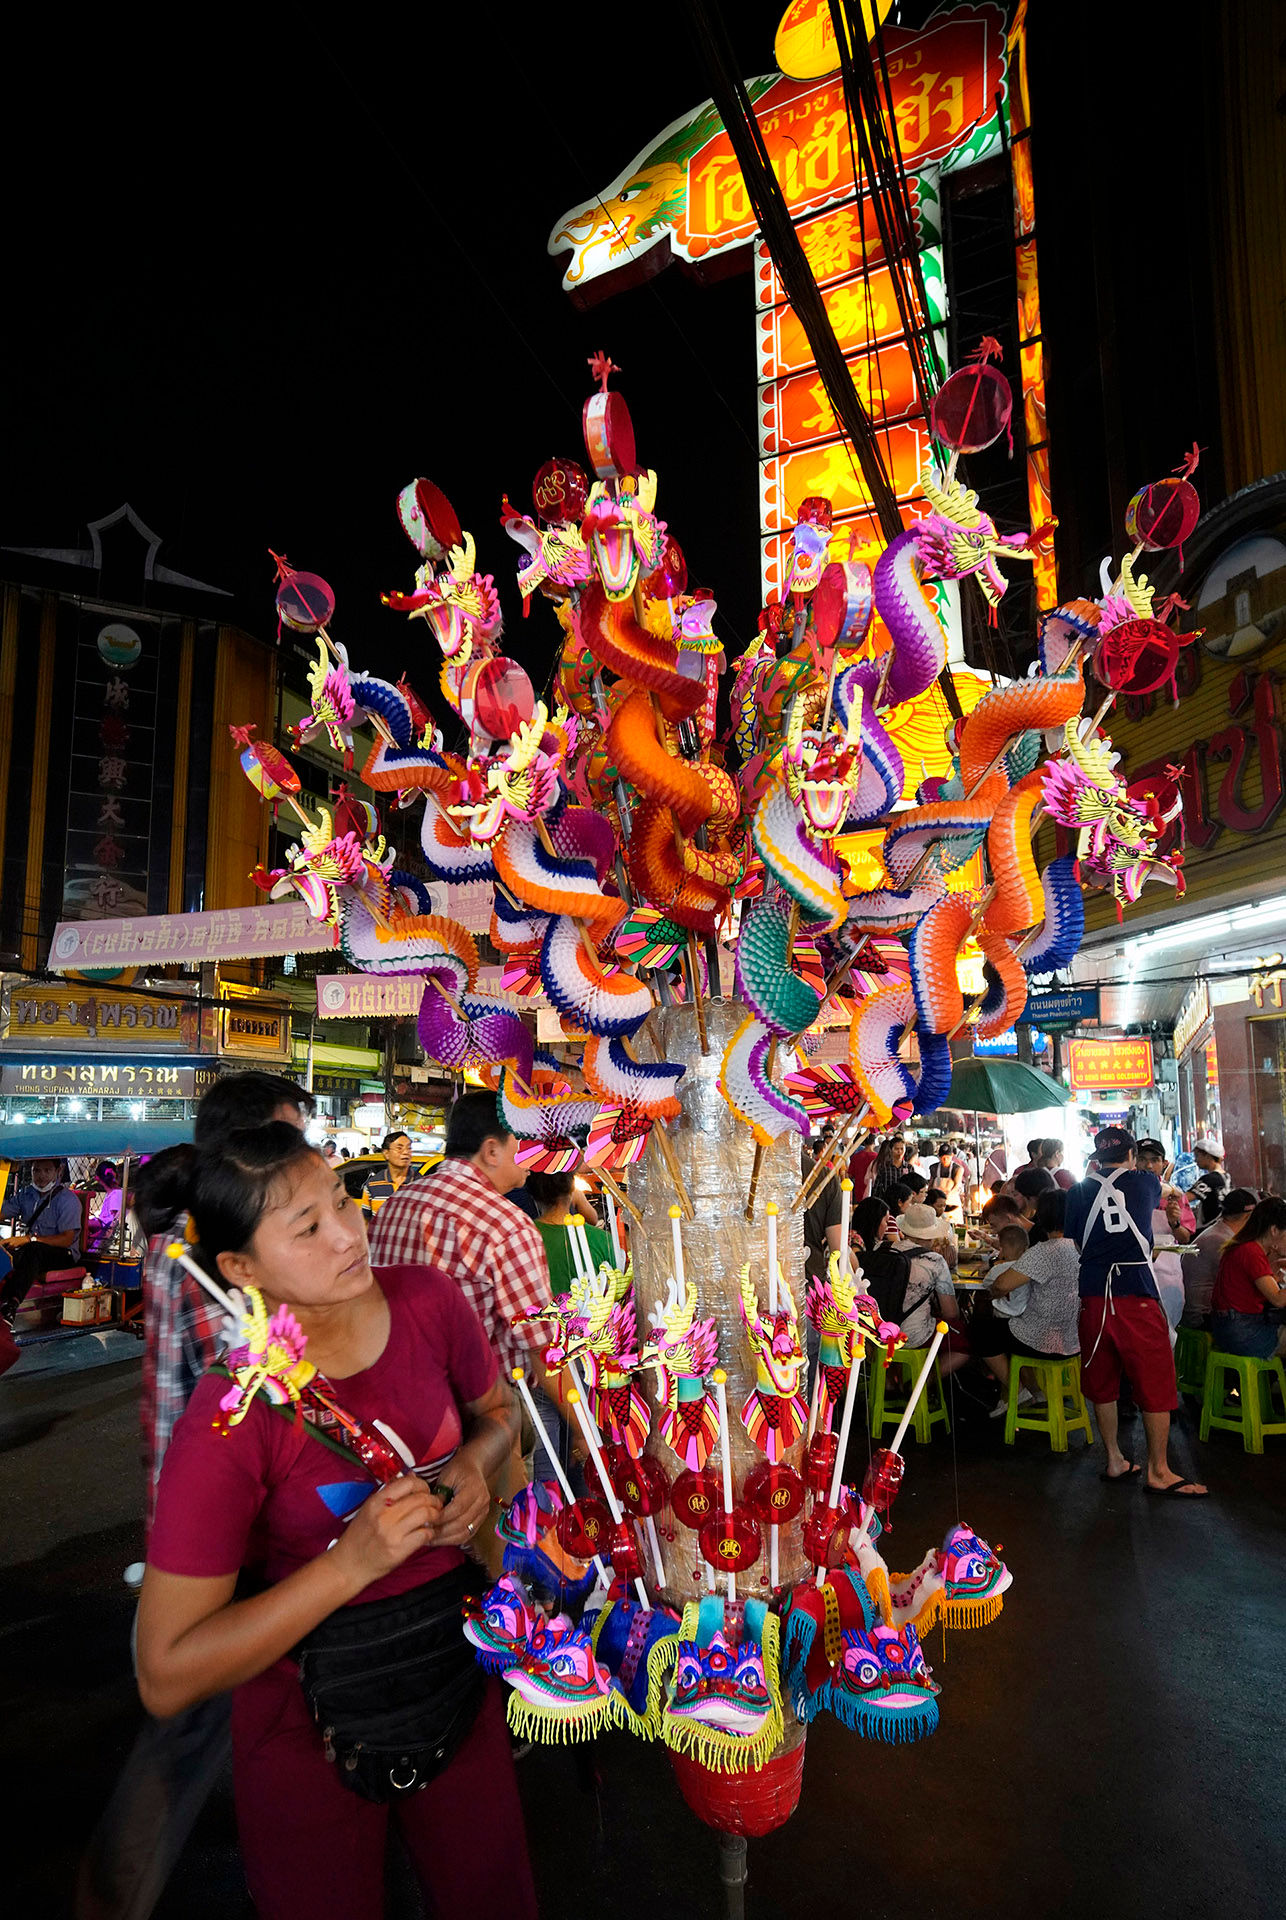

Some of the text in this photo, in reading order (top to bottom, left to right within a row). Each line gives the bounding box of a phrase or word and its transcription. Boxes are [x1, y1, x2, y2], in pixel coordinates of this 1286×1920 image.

[16, 997, 179, 1037] ทองสุพรรณ
[15, 1085, 40, 1093] THONG
